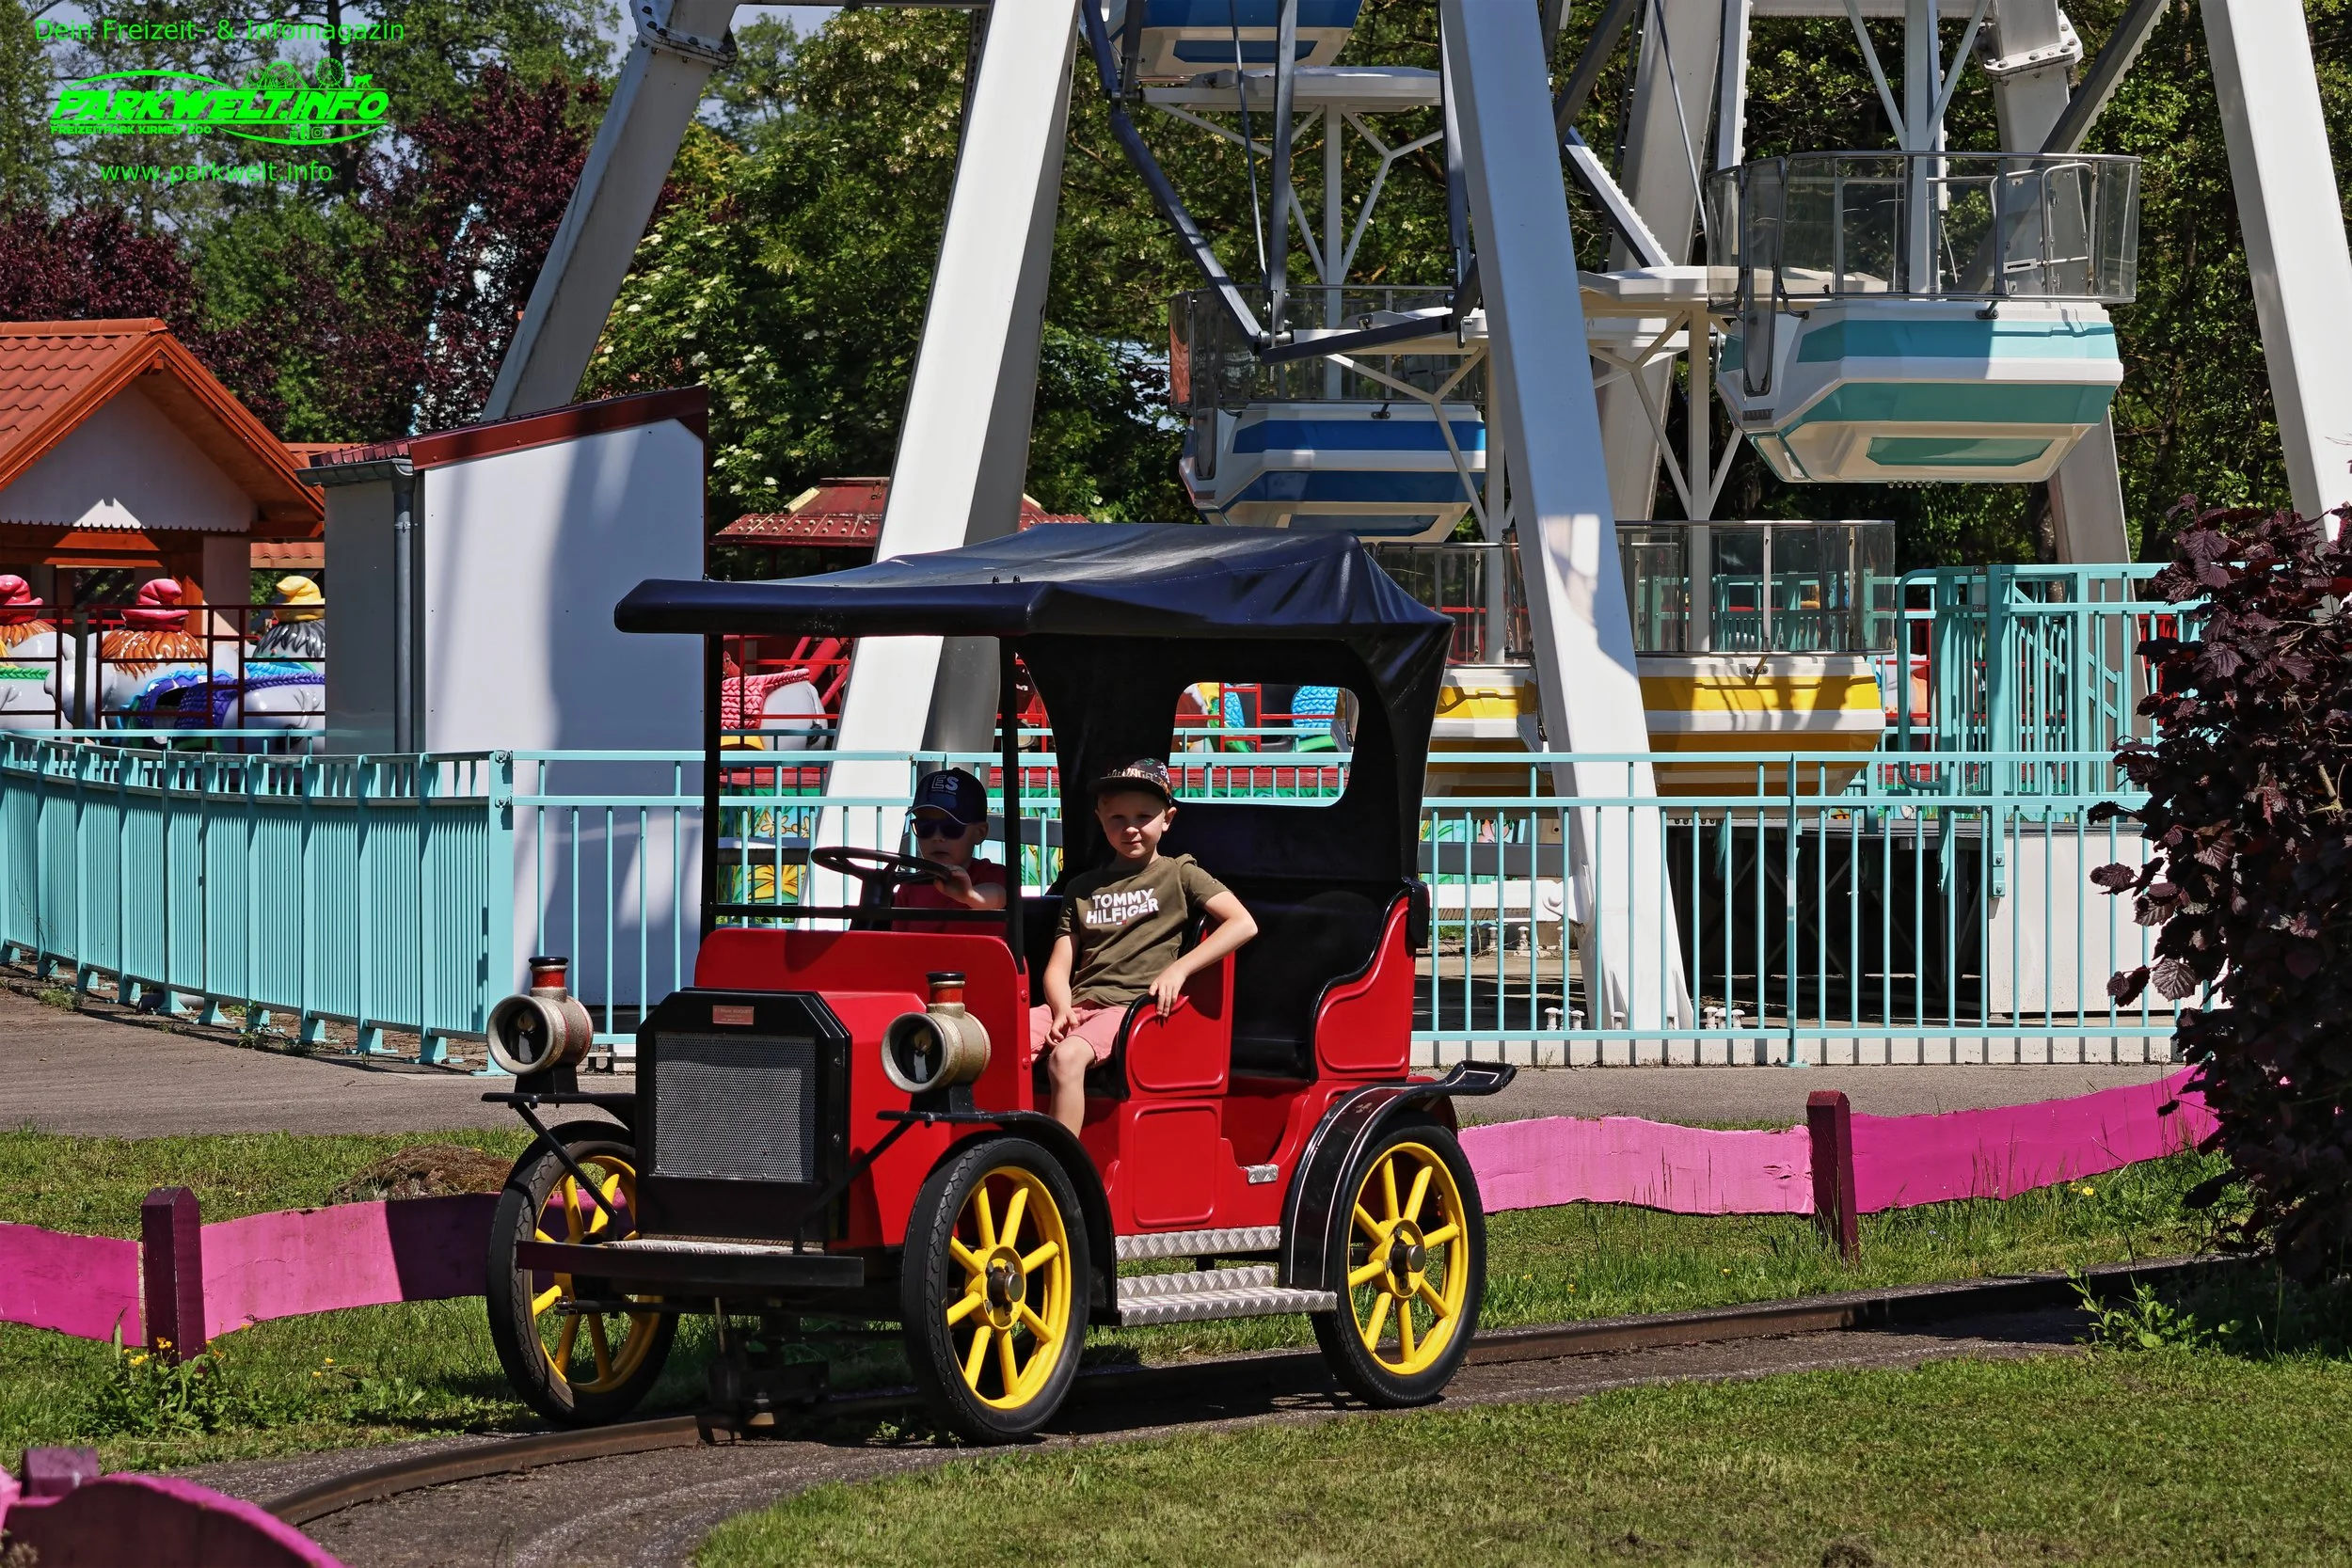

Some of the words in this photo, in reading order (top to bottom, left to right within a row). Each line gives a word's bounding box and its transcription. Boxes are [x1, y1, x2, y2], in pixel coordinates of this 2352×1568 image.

[931, 774, 960, 791] ES
[1092, 888, 1154, 910] TOMMY
[1086, 897, 1159, 924] HILFIGER
